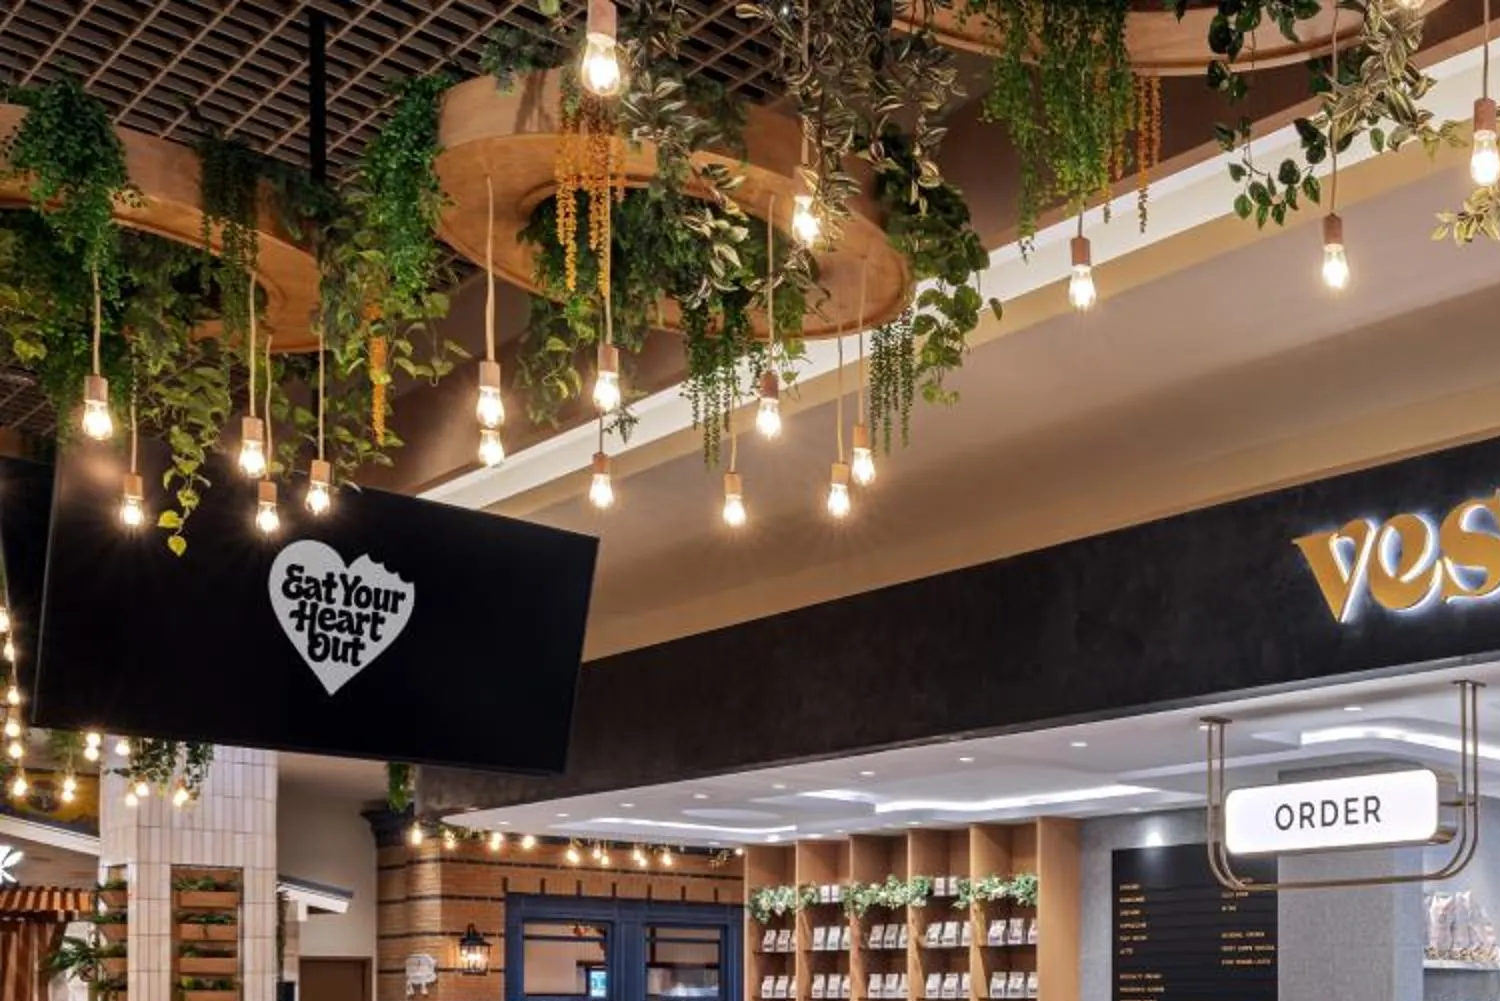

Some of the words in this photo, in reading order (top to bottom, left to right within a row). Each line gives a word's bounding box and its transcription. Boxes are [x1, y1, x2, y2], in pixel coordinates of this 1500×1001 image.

[281, 563, 338, 605] Eat
[339, 573, 407, 615] Your
[289, 600, 387, 643] Heart
[307, 631, 366, 667] Out
[1274, 795, 1382, 832] ORDER
